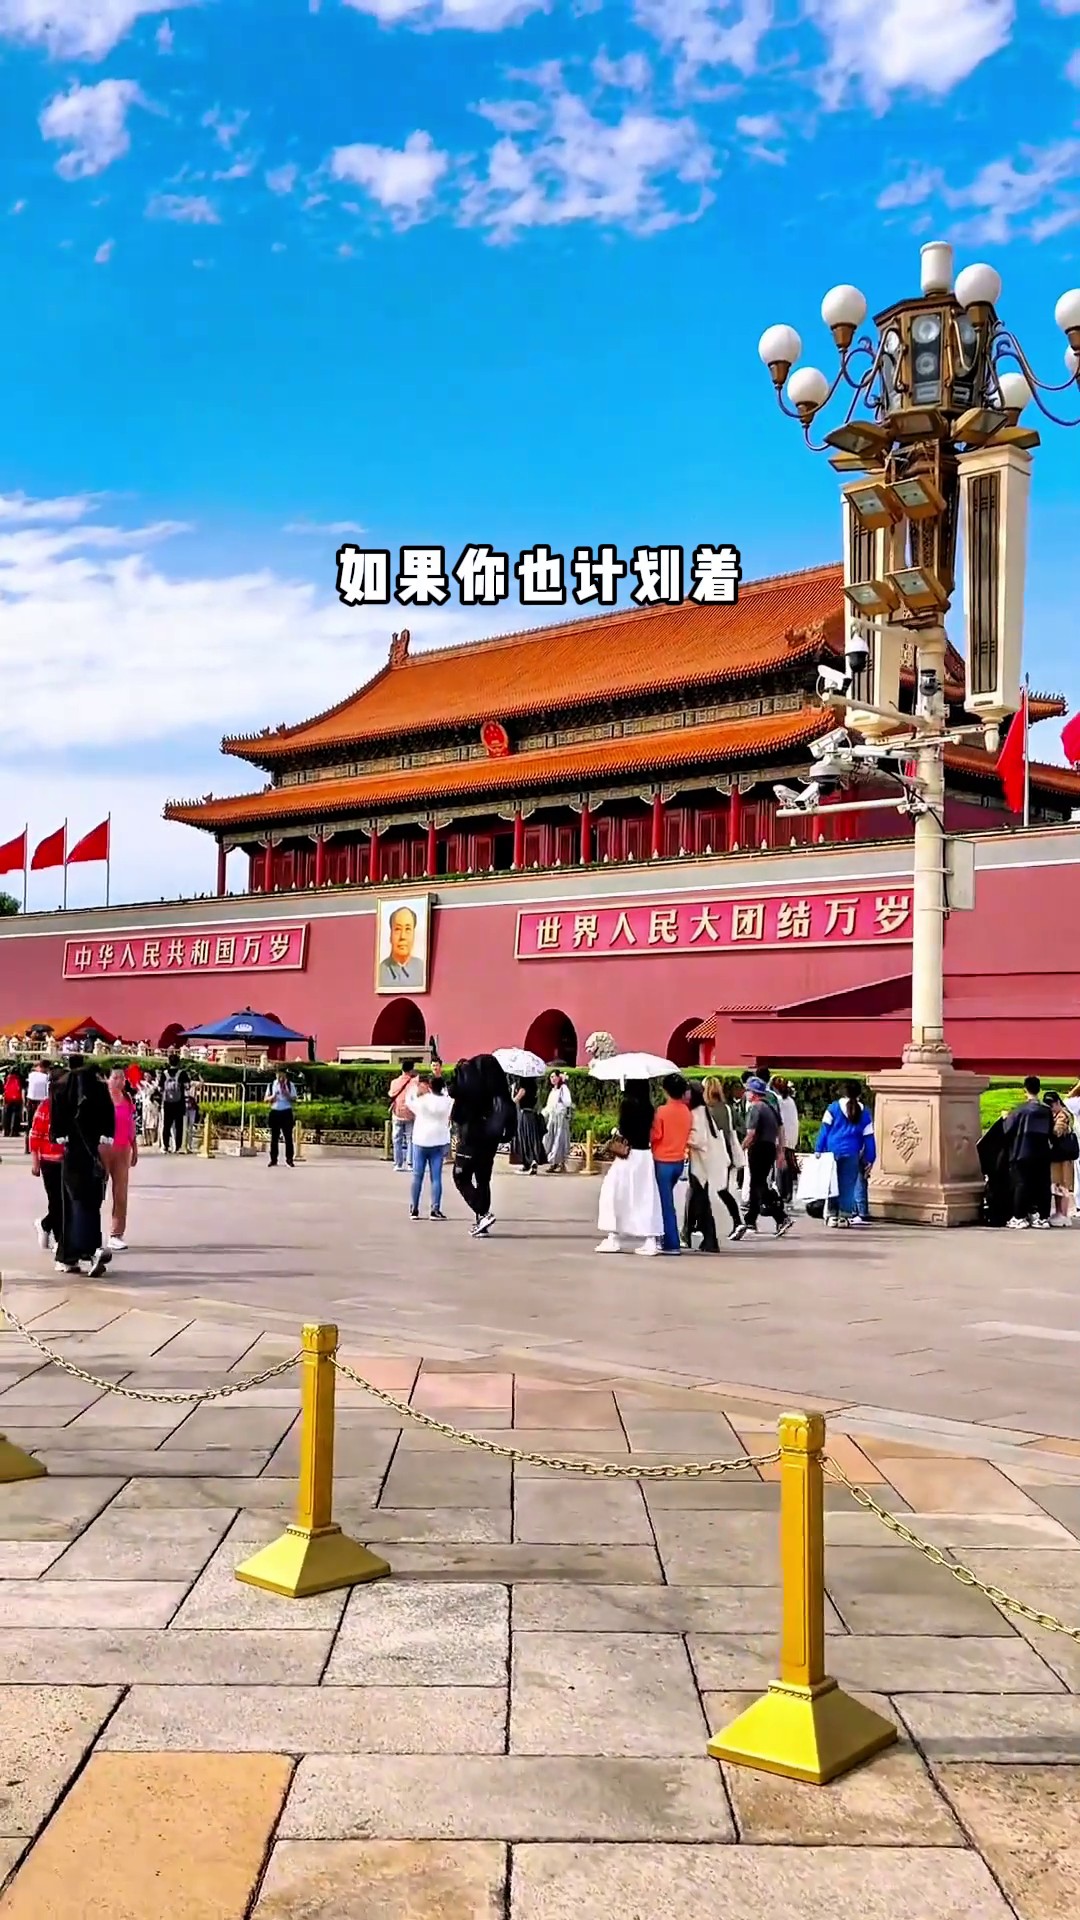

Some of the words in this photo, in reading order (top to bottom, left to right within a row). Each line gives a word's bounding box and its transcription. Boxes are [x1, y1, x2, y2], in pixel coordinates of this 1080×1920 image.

[536, 895, 912, 950] 世界人民大团结万岁
[74, 933, 291, 971] 中华人民共和国万岁
